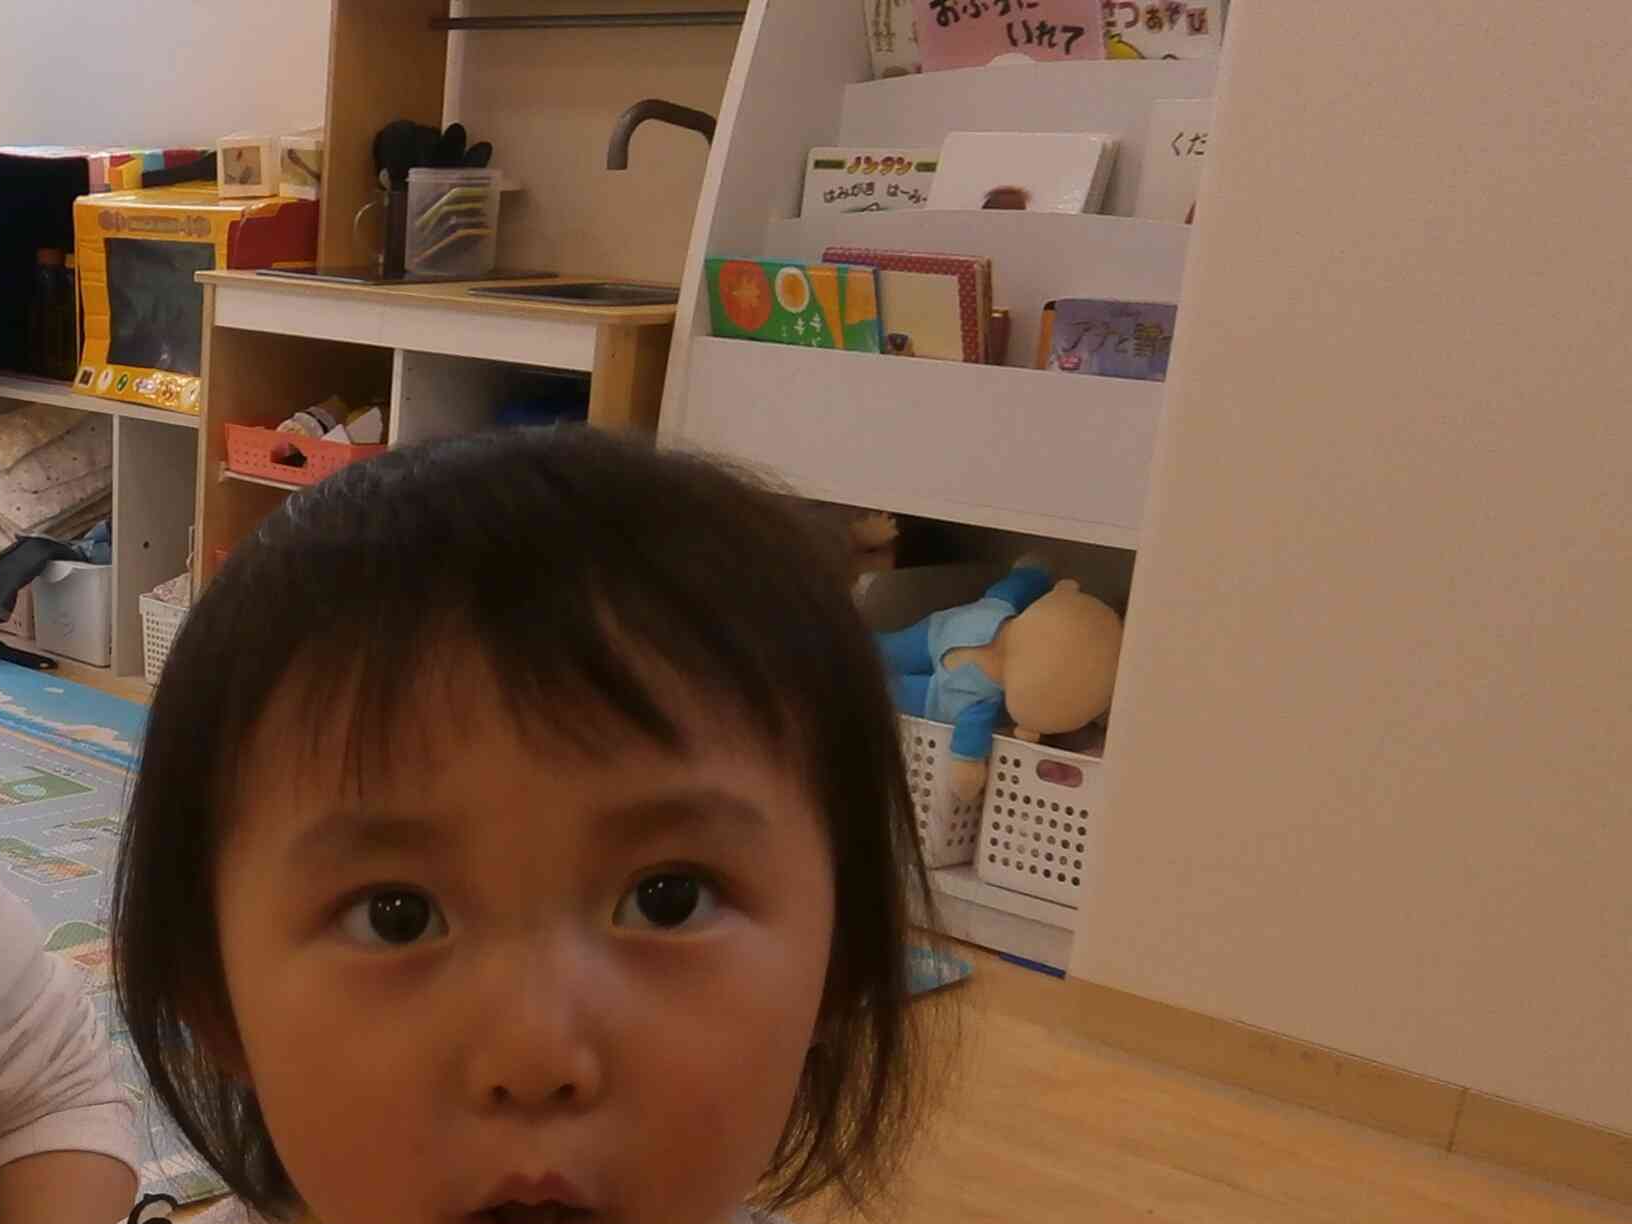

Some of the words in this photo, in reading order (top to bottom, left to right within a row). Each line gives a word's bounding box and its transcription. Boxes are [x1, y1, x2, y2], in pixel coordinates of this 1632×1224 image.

[1006, 20, 1085, 54] いれて
[847, 156, 913, 176] ノンタン
[823, 181, 875, 203] はみがき
